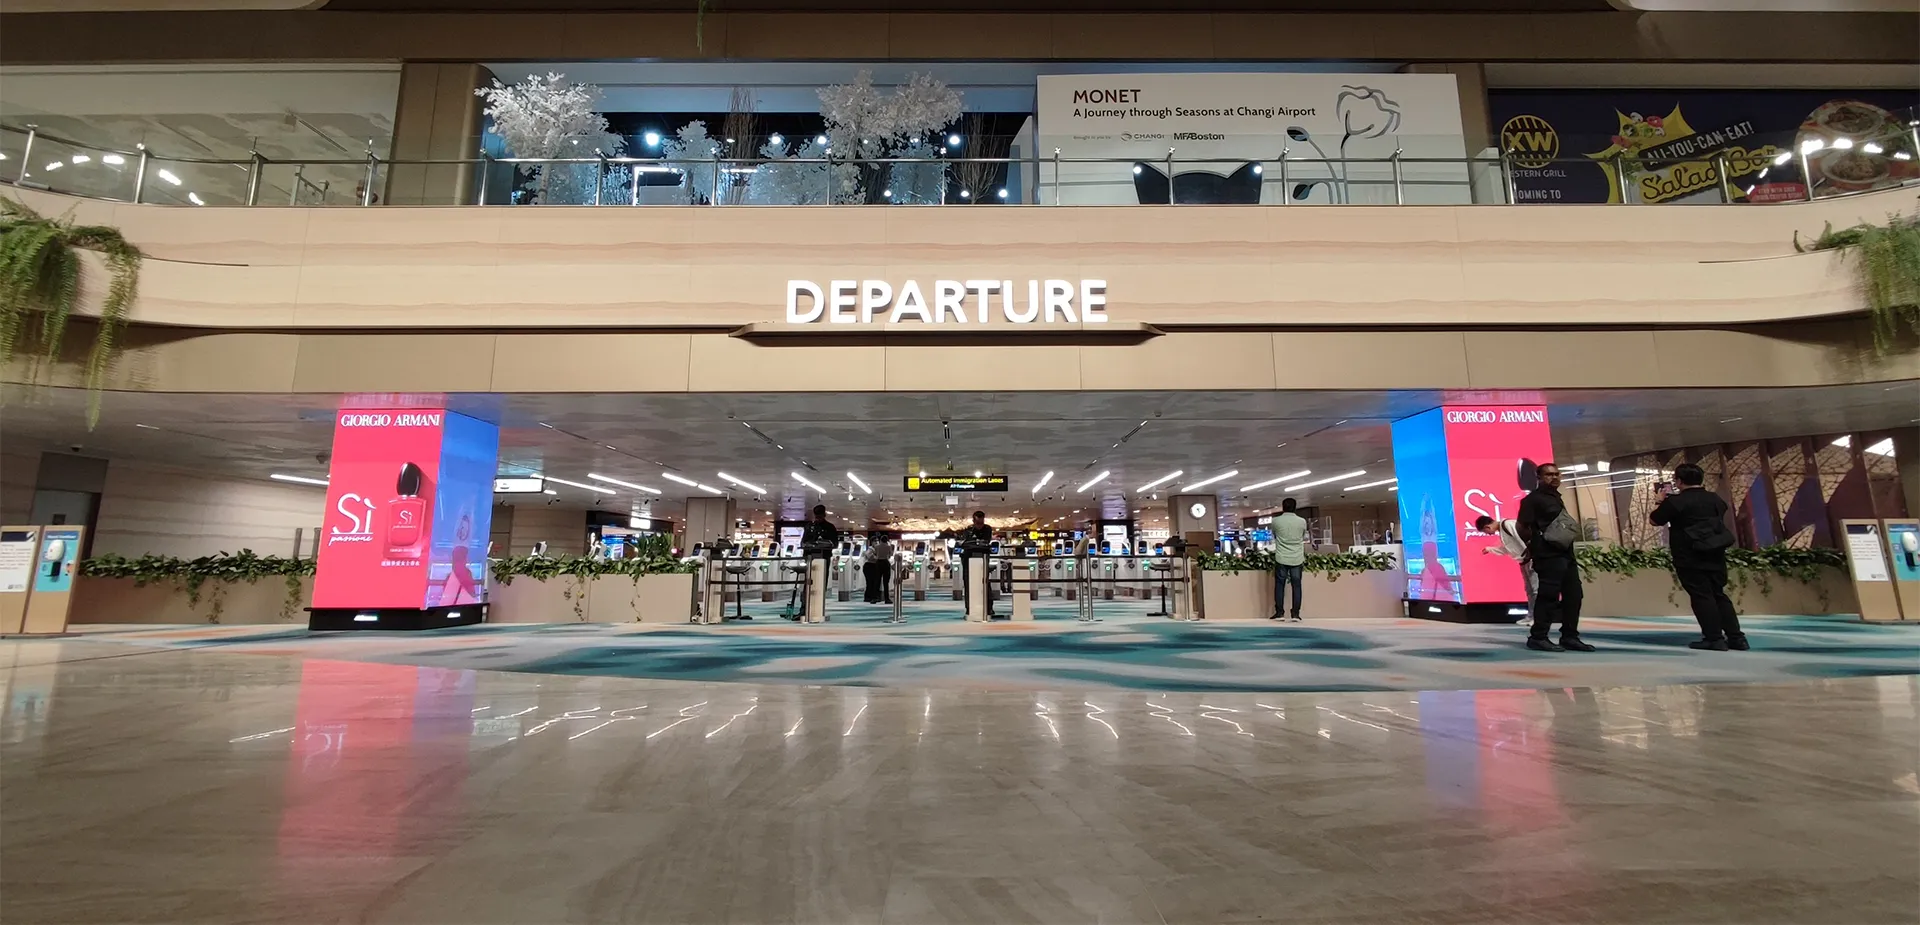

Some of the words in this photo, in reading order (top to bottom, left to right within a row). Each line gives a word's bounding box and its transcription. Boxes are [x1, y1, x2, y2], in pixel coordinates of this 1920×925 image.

[1073, 89, 1141, 104] MONET
[1073, 108, 1081, 117] A
[1084, 108, 1126, 119] Journey
[1129, 107, 1172, 119] through
[1175, 107, 1221, 117] Seasons
[1223, 107, 1234, 116] at
[1237, 107, 1275, 118] Changi
[1277, 107, 1316, 118] Airport
[1504, 131, 1553, 152] XW
[1543, 169, 1567, 178] GRILL
[1643, 160, 1717, 200] Salad
[1514, 189, 1547, 200] OMING
[1549, 189, 1562, 200] TO
[786, 279, 1109, 323] DEPARTURE
[341, 414, 391, 427] GIORGIO
[393, 413, 440, 427] ARMANI
[1447, 410, 1496, 423] GIORGIO
[1499, 410, 1544, 423] ARMANI
[328, 535, 373, 547] passione
